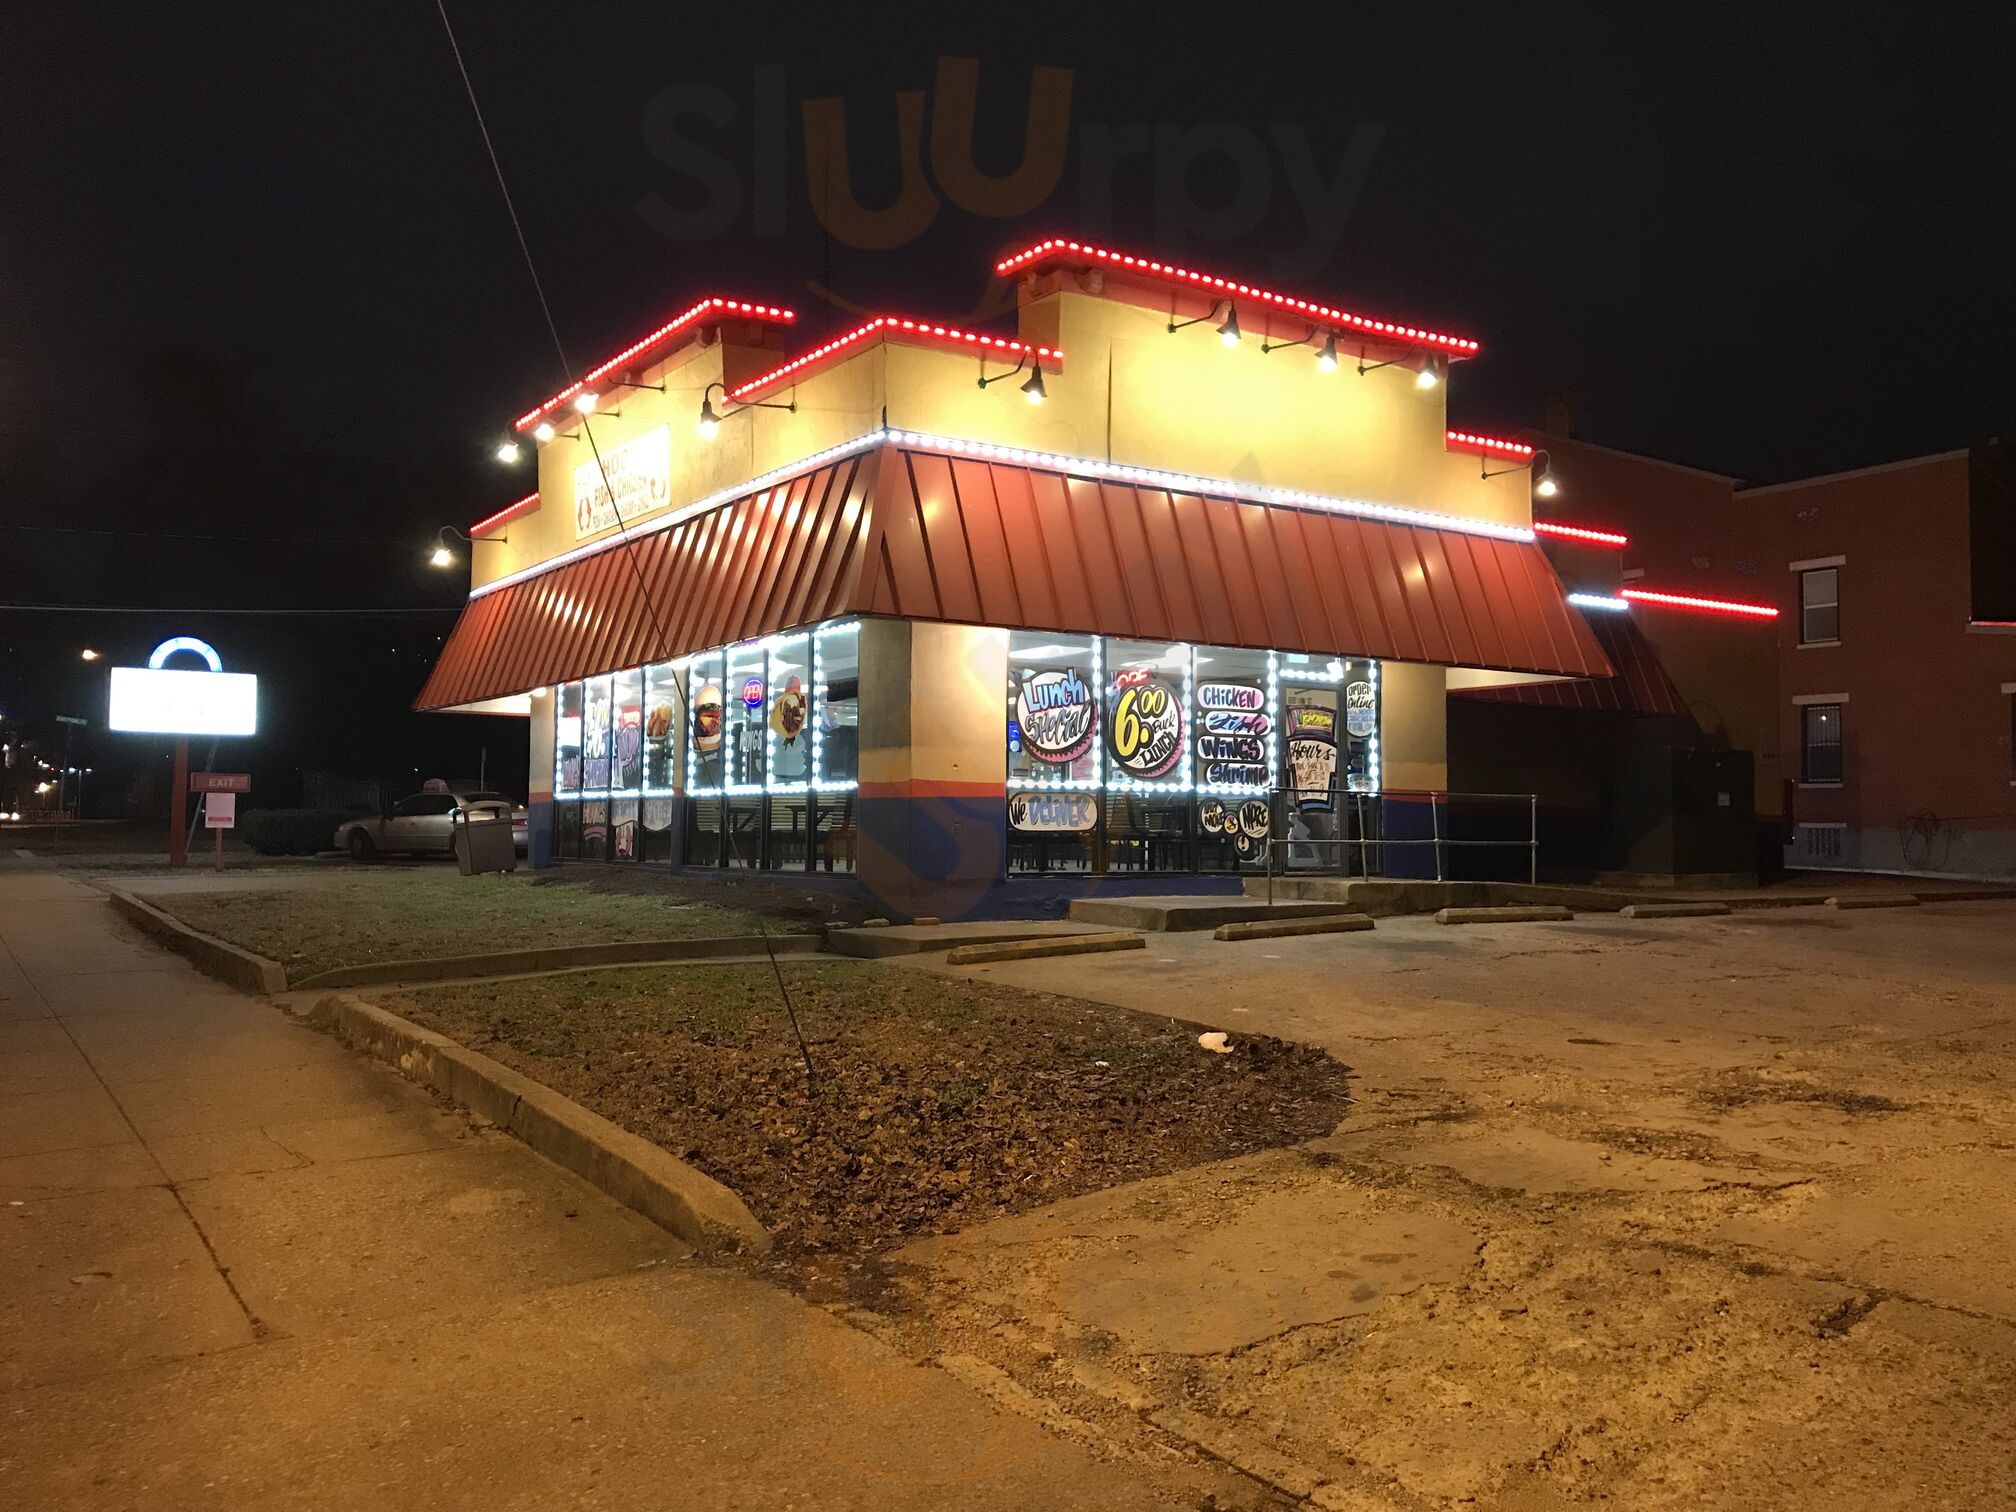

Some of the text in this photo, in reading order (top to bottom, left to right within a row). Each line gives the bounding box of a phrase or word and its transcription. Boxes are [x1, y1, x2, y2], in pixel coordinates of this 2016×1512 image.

[744, 684, 763, 700] OPEN
[1022, 666, 1085, 714] Lunch
[1291, 741, 1335, 761] Hours
[208, 778, 233, 788] EXIT
[1011, 798, 1028, 826] We
